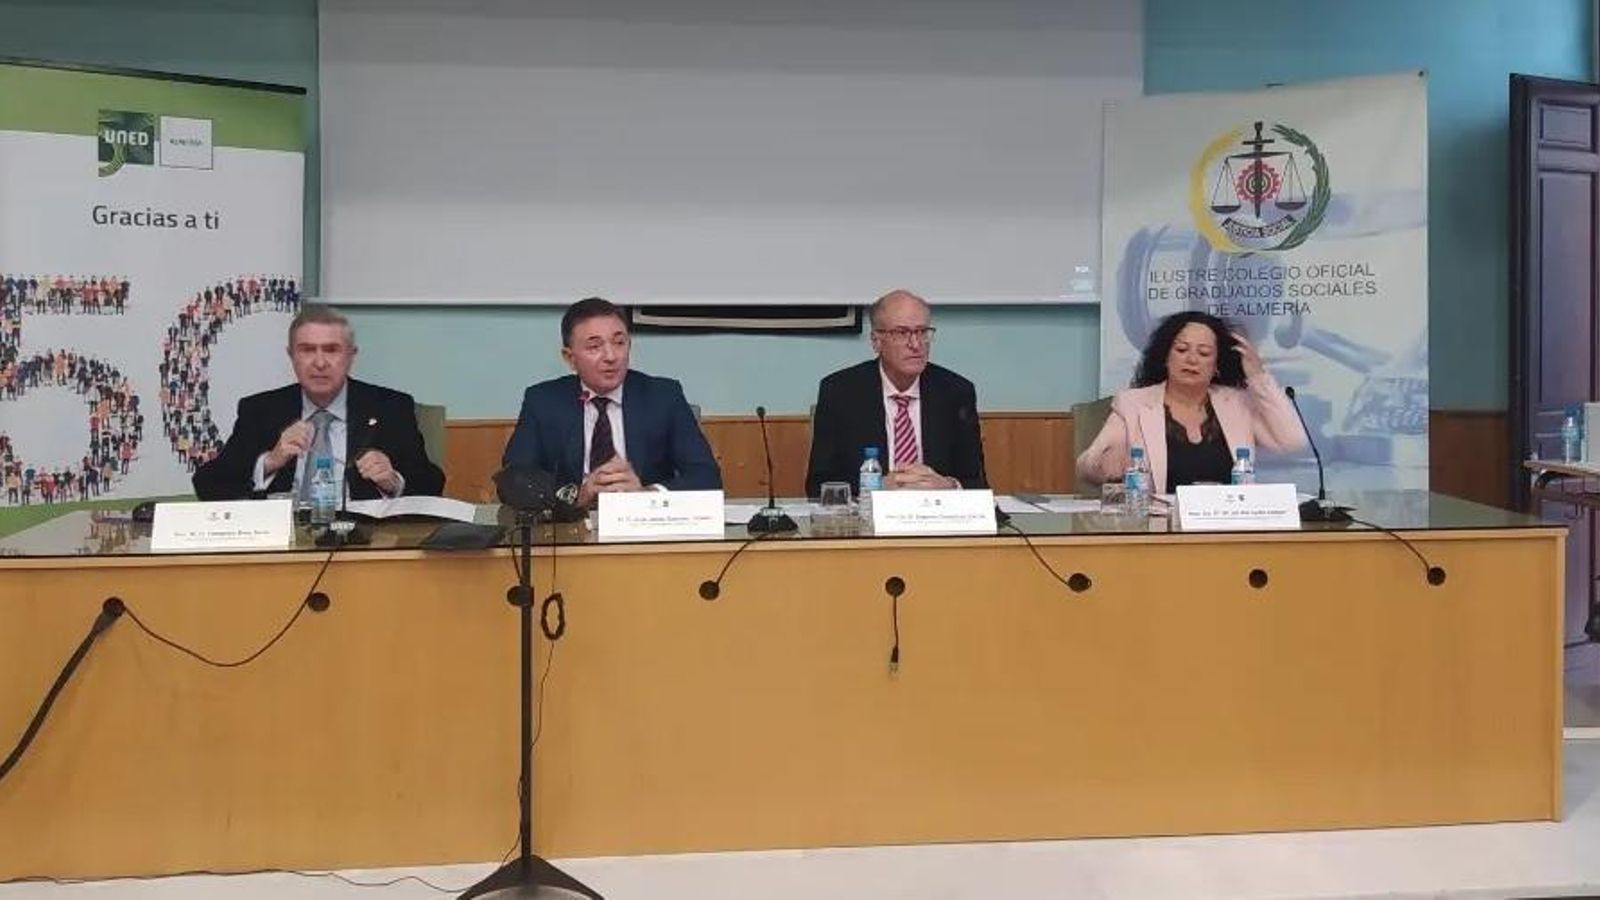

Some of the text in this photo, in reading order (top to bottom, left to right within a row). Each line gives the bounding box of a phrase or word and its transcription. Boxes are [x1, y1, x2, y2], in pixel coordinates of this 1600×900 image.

[104, 129, 149, 146] UNED
[91, 204, 220, 230] Gracias a ti
[1150, 263, 1376, 283] ILUSTRE COLEGIO OFICIAL
[1148, 281, 1378, 300] DE GRADUADOS SOCIALES
[1207, 300, 1312, 316] DE ALMERÍA
